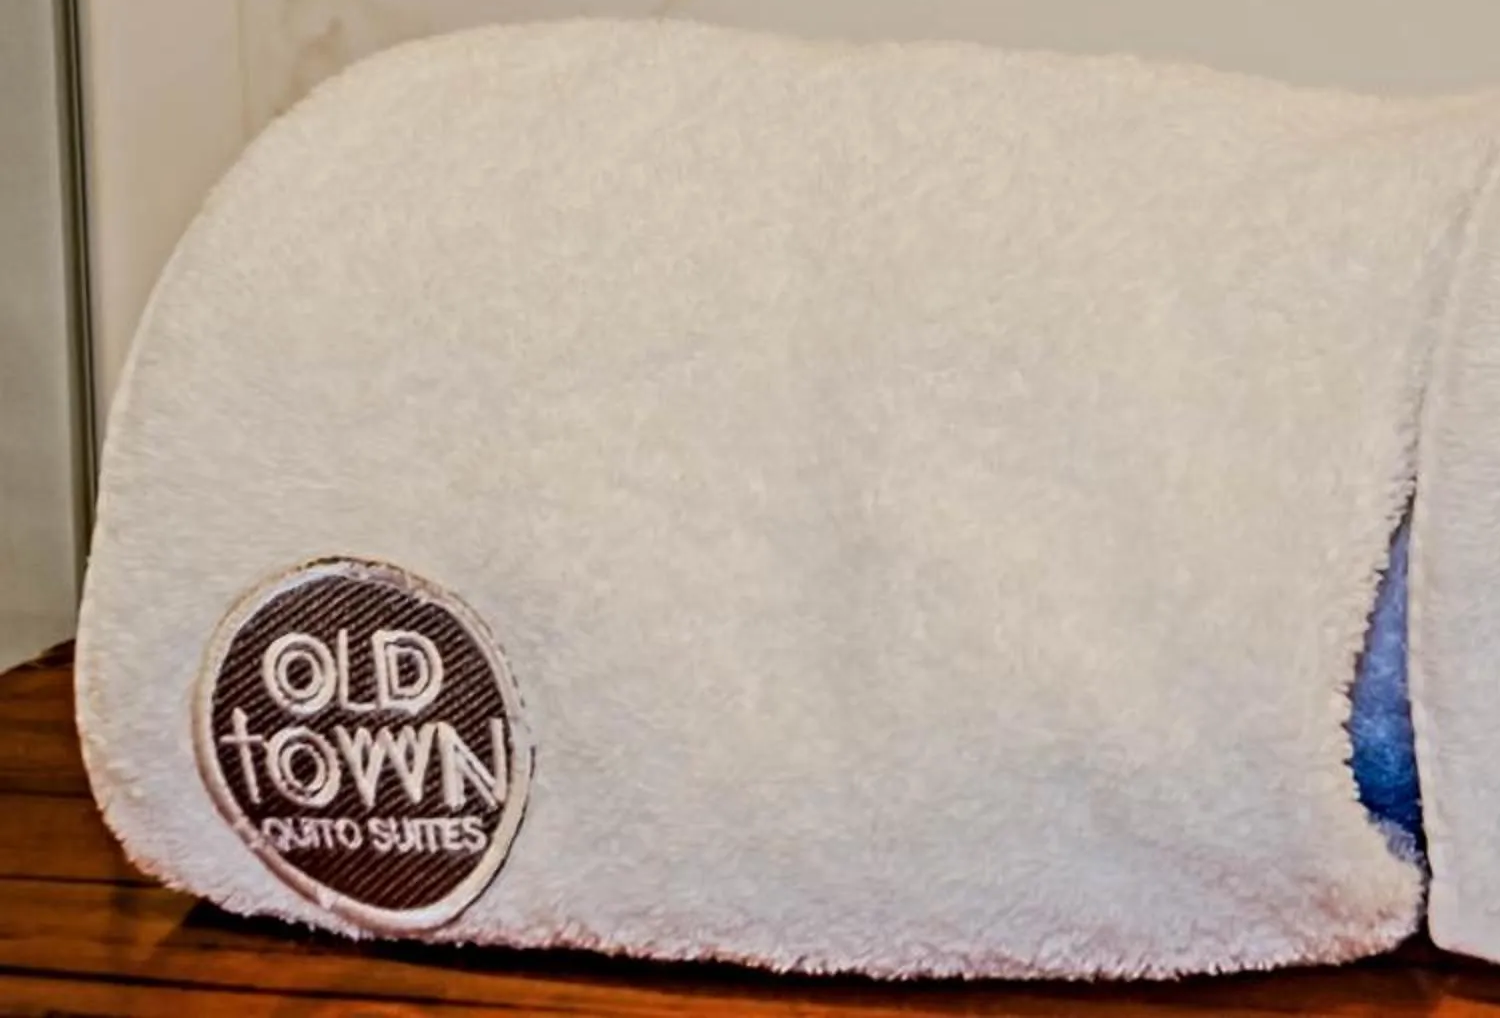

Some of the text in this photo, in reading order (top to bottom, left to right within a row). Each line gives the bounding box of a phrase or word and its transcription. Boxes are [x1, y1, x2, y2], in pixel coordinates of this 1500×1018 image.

[262, 628, 445, 715] OLD
[261, 816, 488, 853] QUITO SUITES
